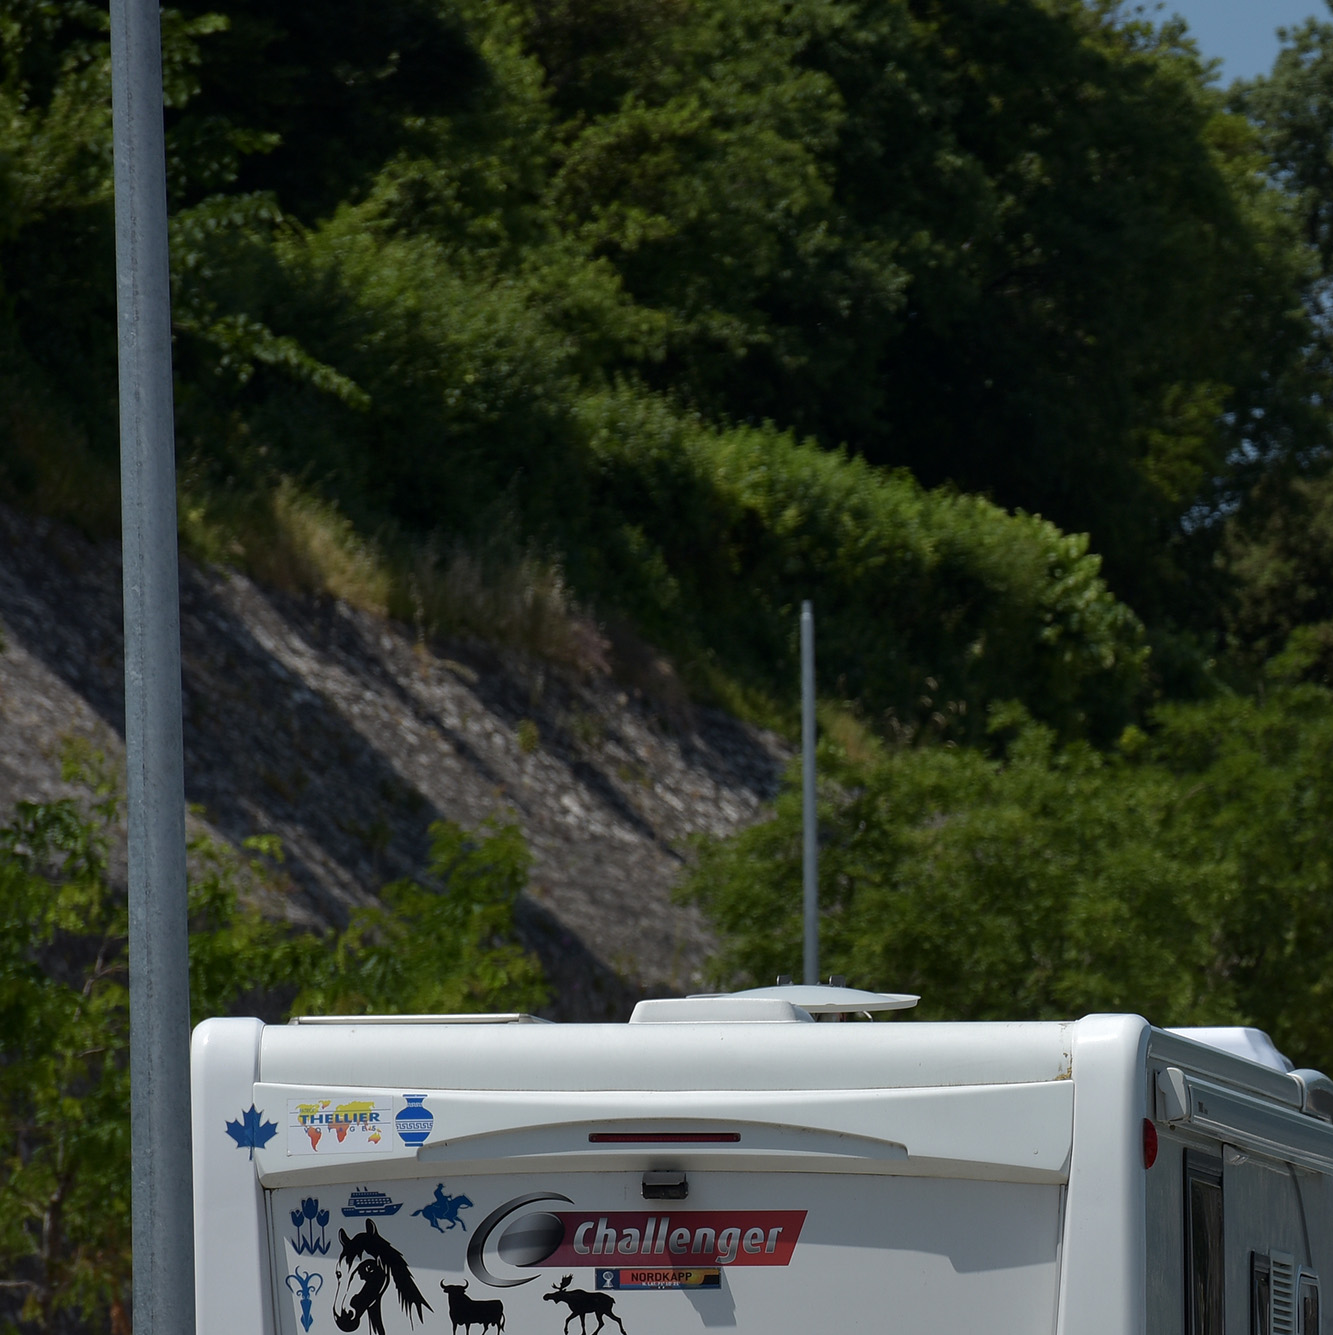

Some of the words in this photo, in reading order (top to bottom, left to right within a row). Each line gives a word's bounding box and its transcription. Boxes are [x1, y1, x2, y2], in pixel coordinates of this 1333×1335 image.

[300, 1112, 380, 1124] THELLIER
[304, 1125, 376, 1133] VOYAGES
[573, 1217, 783, 1264] Challenger
[631, 1272, 692, 1282] NORDKAPP
